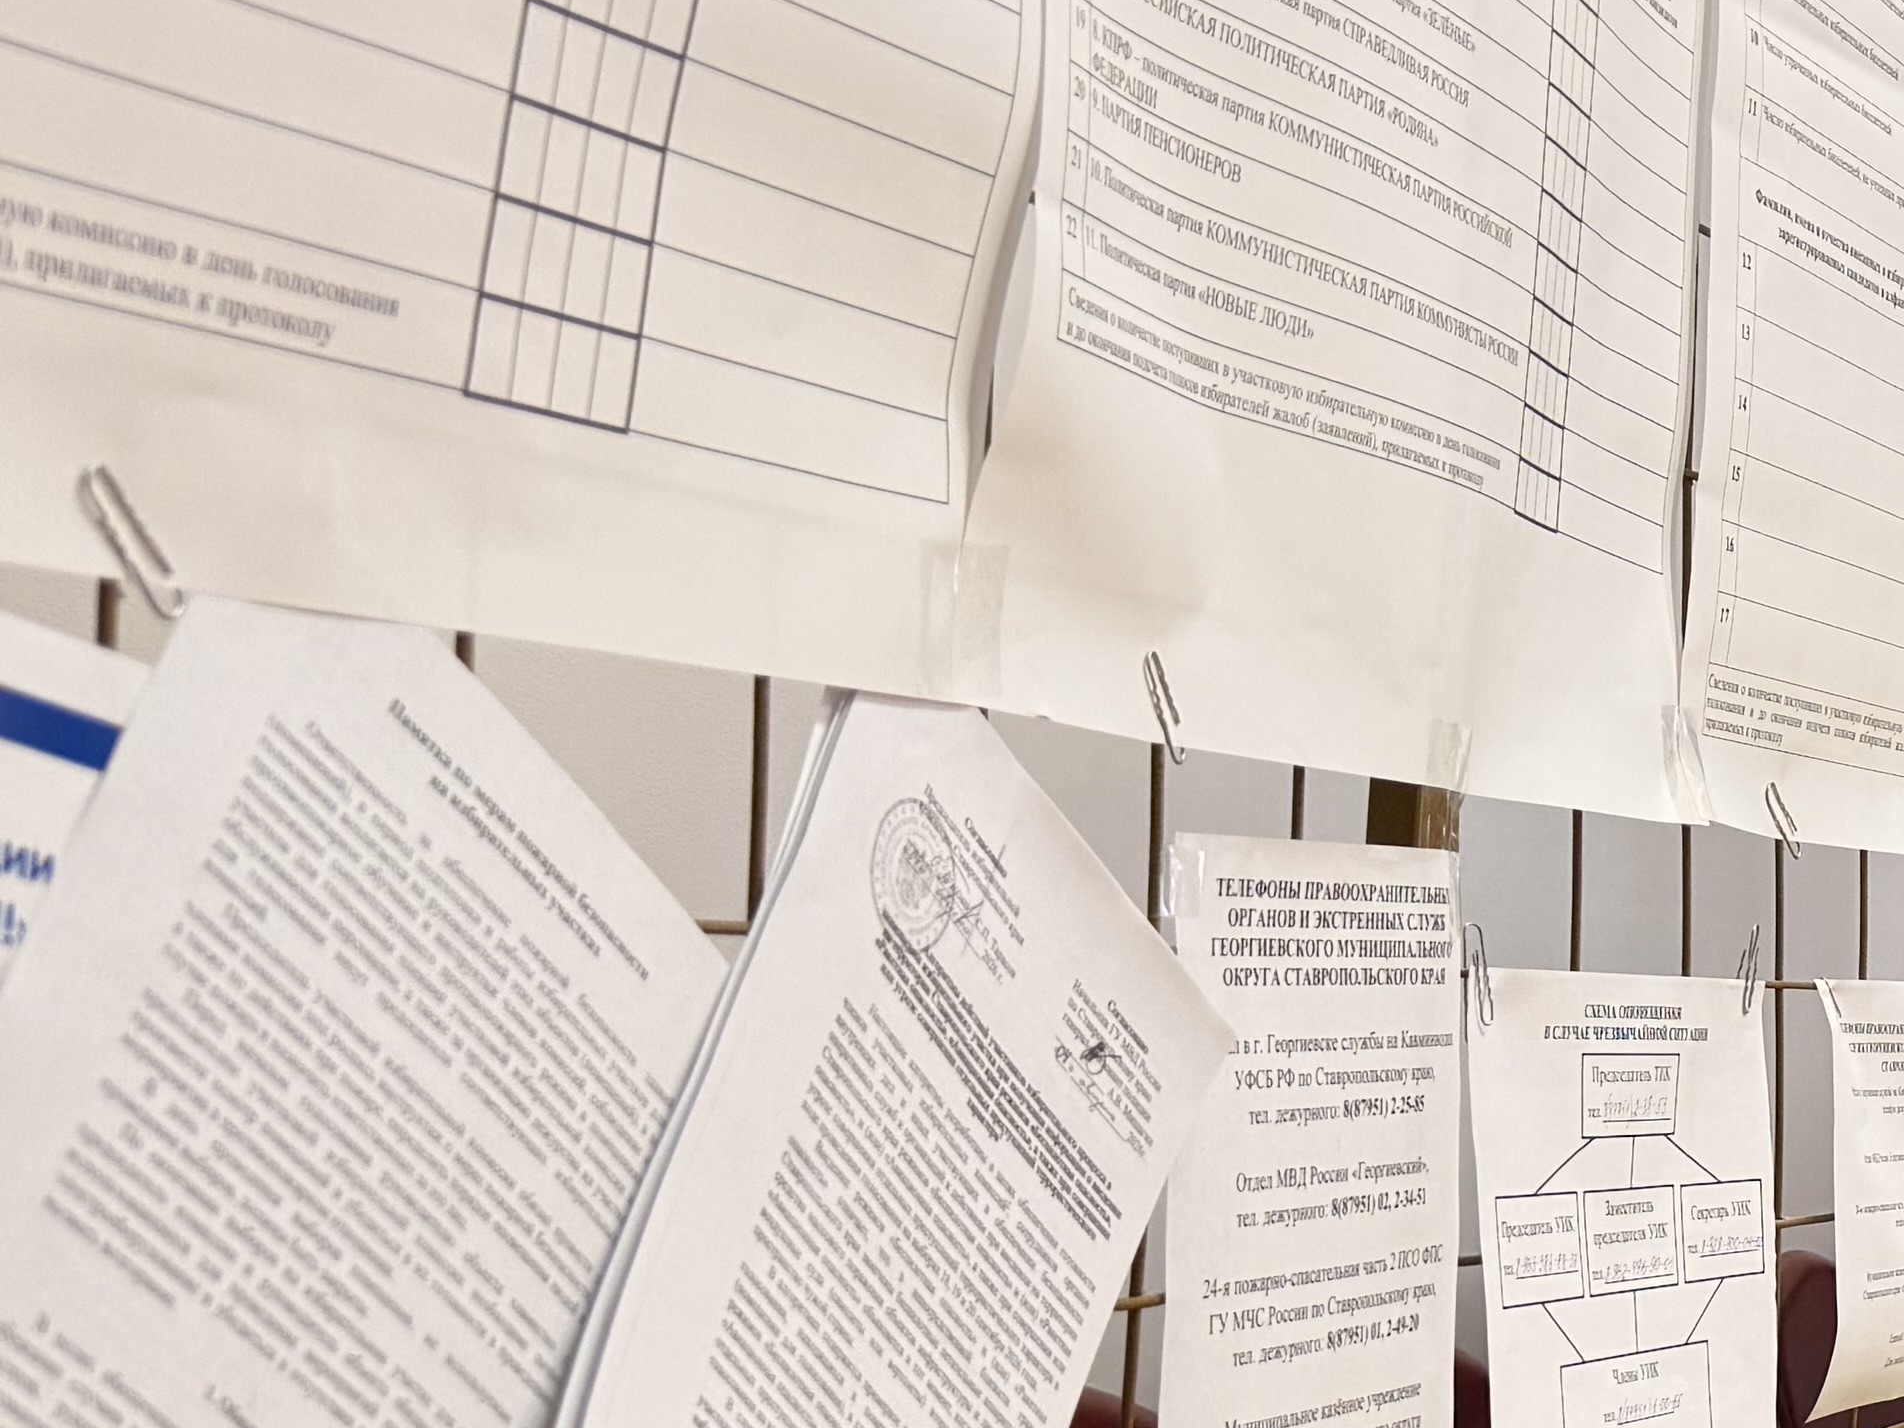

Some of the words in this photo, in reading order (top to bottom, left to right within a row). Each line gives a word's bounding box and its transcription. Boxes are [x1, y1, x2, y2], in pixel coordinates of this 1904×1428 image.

[1303, 0, 1341, 32] партия
[1342, 17, 1429, 83] СПРАВЕДЛИВАЯ
[1219, 22, 1336, 92] ПОЛИТИЧЕСКАЯ
[1339, 79, 1385, 118] ПАРТИЯ
[1143, 121, 1242, 184] ПЕНСИОНЕРОВ
[1221, 92, 1265, 126] партия
[1268, 111, 1411, 192] КОММУНИСТИЧЕСКАЯ
[1413, 178, 1452, 215] ПАРТИЯ
[1206, 219, 1367, 296] КОММУНИСТИЧЕСКАЯ
[1370, 282, 1415, 317] ПАРТИЯ
[261, 262, 400, 318] голосования
[1198, 284, 1258, 322] «НОВЫЕ
[1259, 306, 1315, 339] ЛЮДИ»
[1232, 364, 1303, 401] участковую
[1216, 878, 1300, 899] ТЕЛЕФОНЫ
[1228, 908, 1296, 928] ОРГАНОВ
[1300, 910, 1309, 928] И
[1313, 910, 1403, 931] ЭКСТРЕННЫХ
[1408, 913, 1446, 932] СЛУЖБ
[1211, 937, 1333, 958] ГЕОРГИЕВСКОГО
[1337, 939, 1452, 961] МУНИЦИПАЛЬНОГО
[1223, 967, 1281, 987] ОКРУГА
[1284, 967, 1418, 986] СТАВРОПОЛЬСКОГО
[1421, 968, 1446, 985] КРАЯ
[1585, 1004, 1616, 1020] СХЕМА
[1268, 1034, 1337, 1057] Георгиевске
[1341, 1032, 1384, 1054] службы
[1235, 1069, 1274, 1089] УФСБ
[1277, 1068, 1295, 1088] РФ
[1298, 1073, 1312, 1087] по
[1249, 1109, 1272, 1125] тел.
[1275, 1106, 1340, 1126] дежурного:
[1343, 1096, 1389, 1121] 8(87951)
[1236, 1171, 1273, 1193] Отдел
[1276, 1167, 1307, 1189] МВД
[1310, 1164, 1349, 1186] России
[1331, 1194, 1375, 1220] 8(87951)
[1202, 1278, 1230, 1299] 24-я
[1234, 1260, 1360, 1296] пожарно-спасательная
[1232, 1307, 1265, 1332] МЧС
[1268, 1303, 1309, 1326] России
